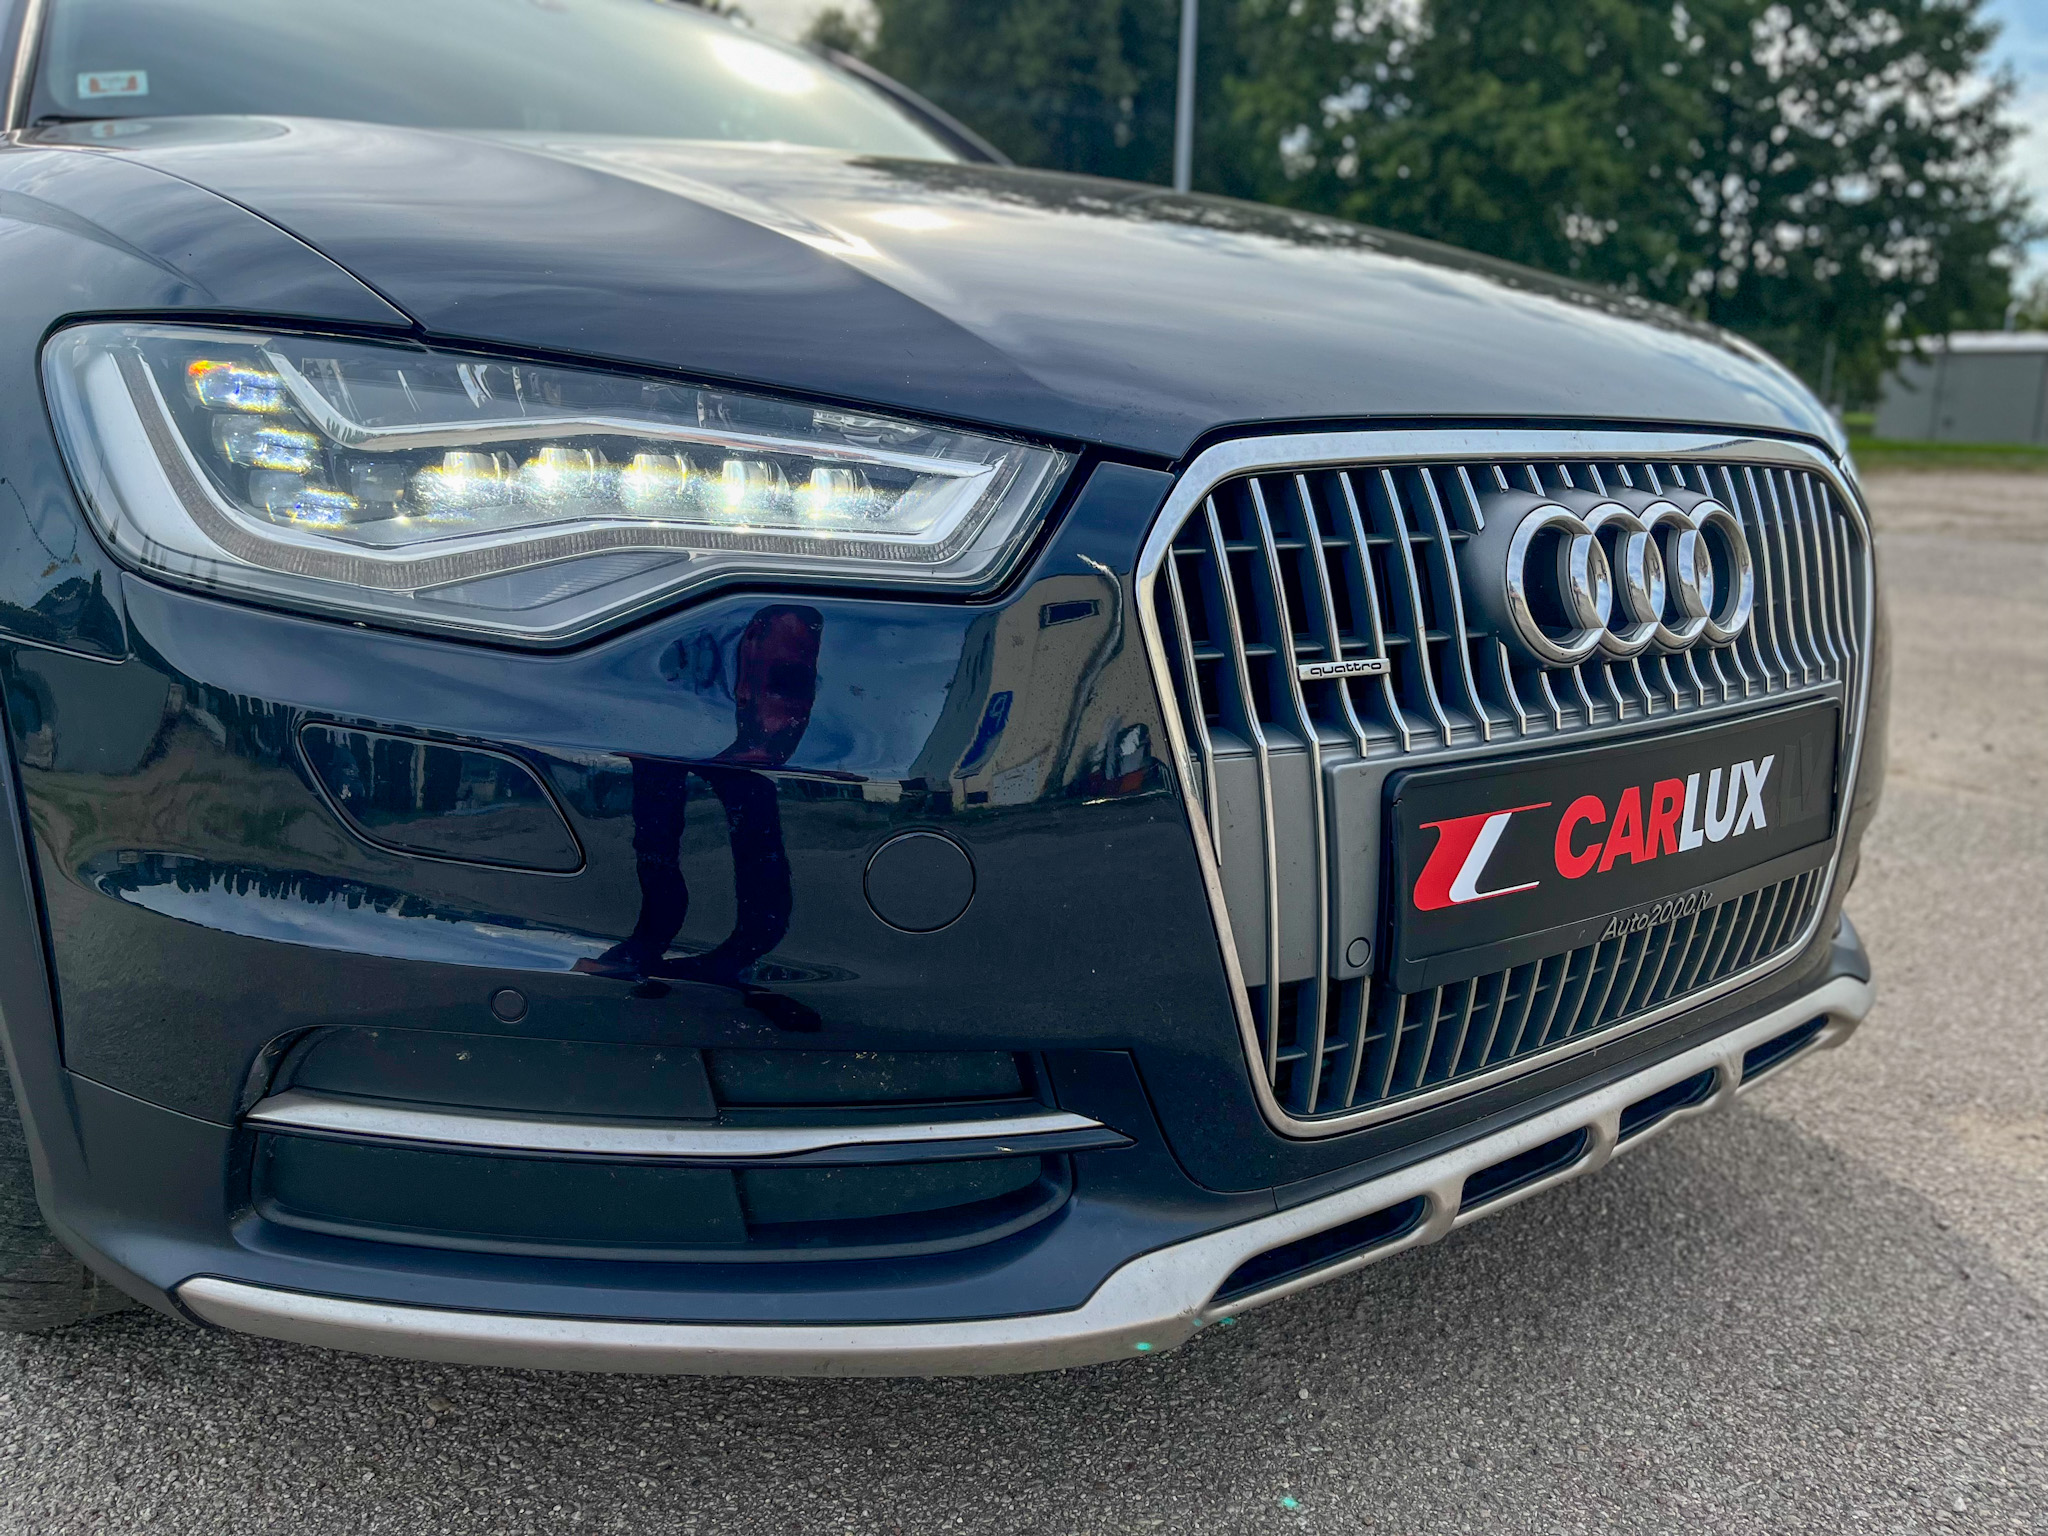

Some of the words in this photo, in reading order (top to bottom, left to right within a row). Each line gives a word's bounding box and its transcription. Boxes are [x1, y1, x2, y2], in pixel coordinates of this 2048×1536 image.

[1310, 662, 1382, 677] quattro
[1554, 755, 1775, 879] CARLUX
[1600, 890, 1713, 941] Auto2000.lv
